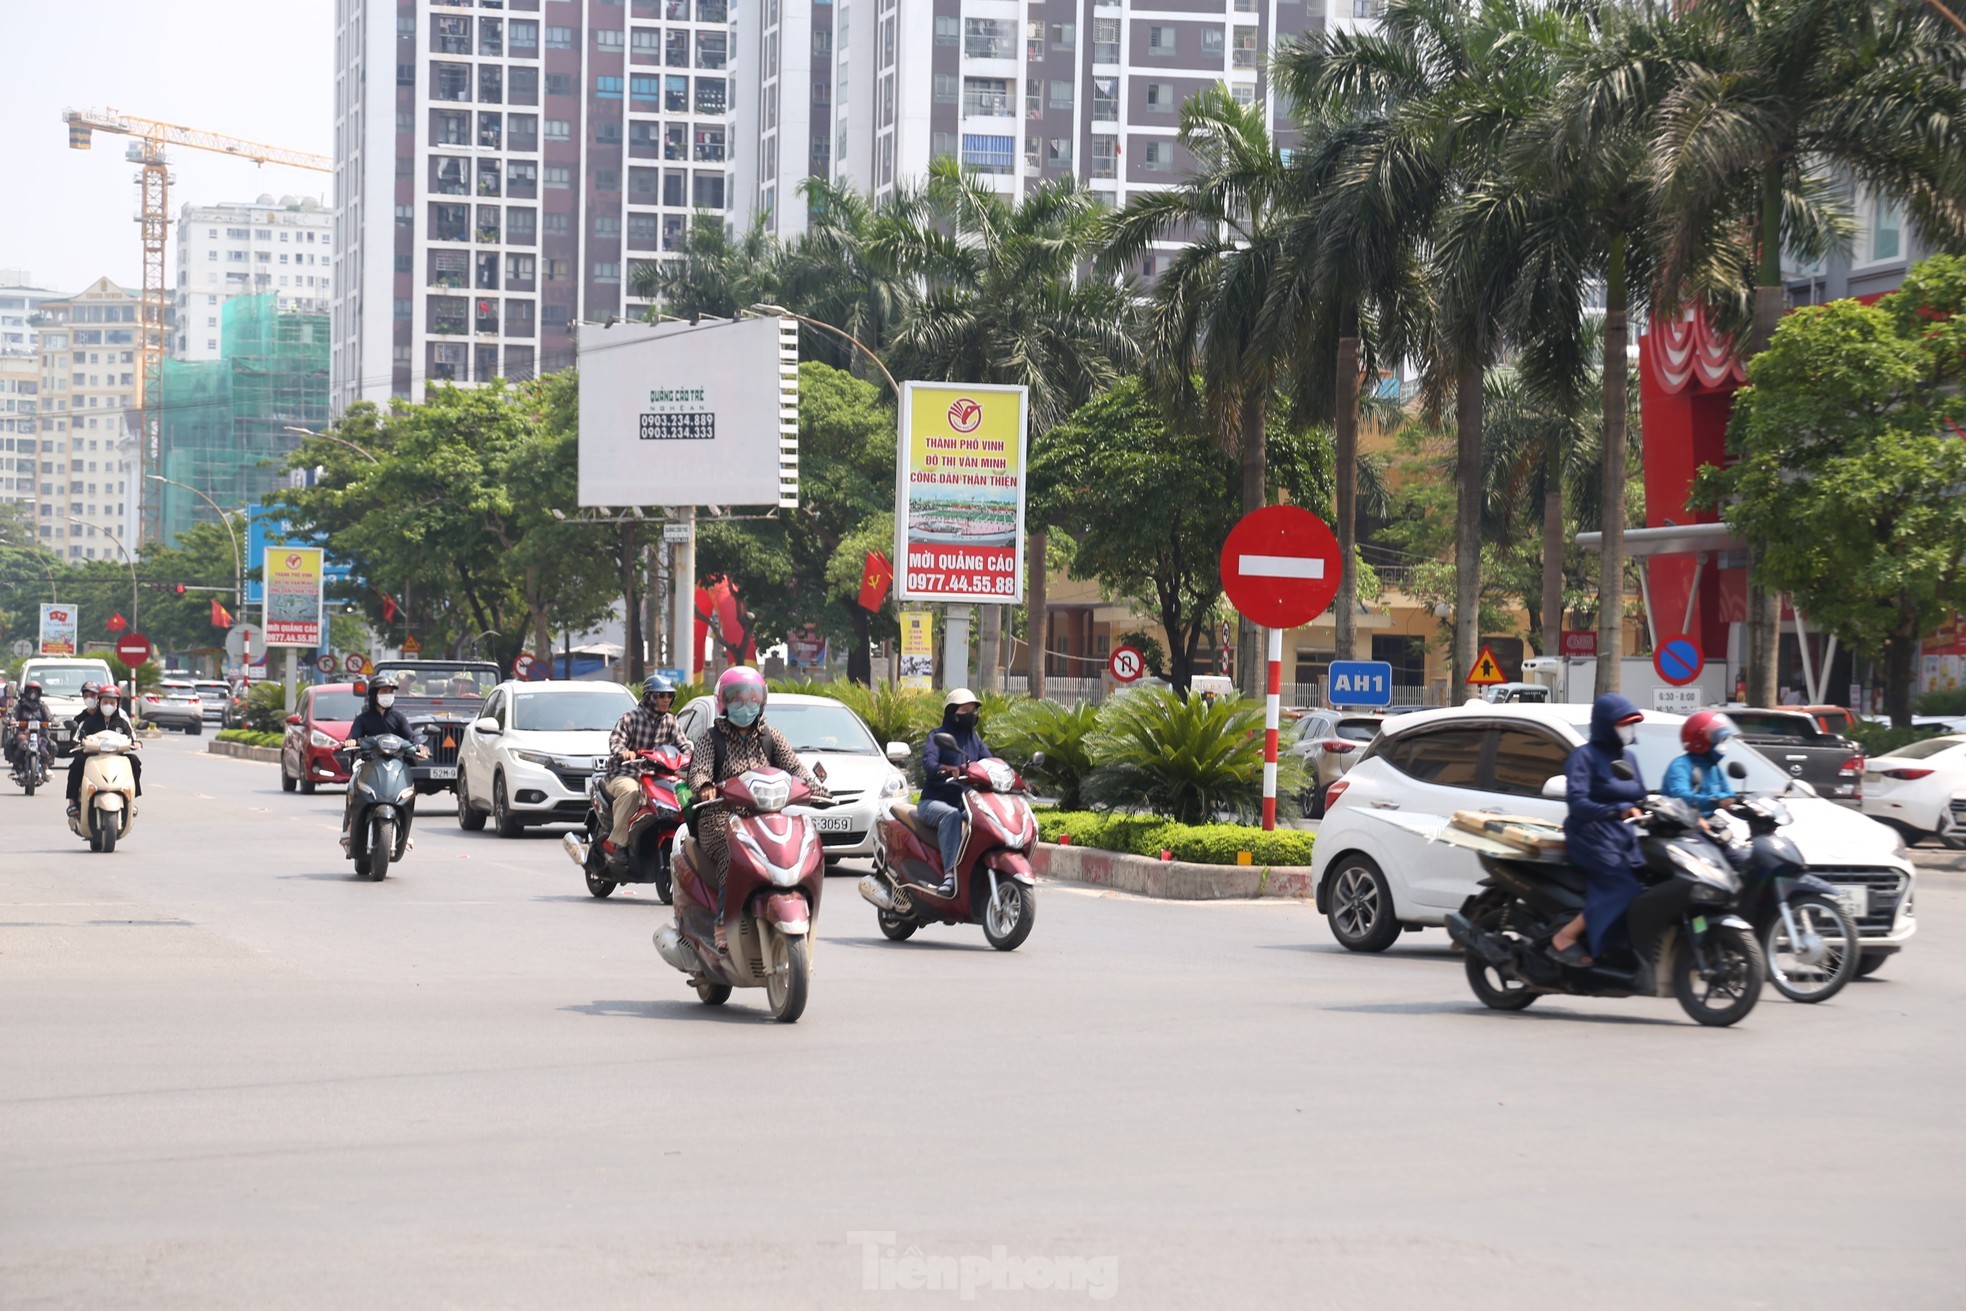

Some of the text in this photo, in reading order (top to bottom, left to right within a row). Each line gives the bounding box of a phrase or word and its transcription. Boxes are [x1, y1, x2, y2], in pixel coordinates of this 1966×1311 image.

[641, 414, 713, 427] 0903.234.889
[641, 426, 713, 439] 0903.234.333
[926, 436, 1004, 451] THÀNH PHỐ VINH
[925, 454, 1006, 469] ĐÔ THỊ VĂN MINH
[910, 470, 936, 484] CÔNG
[939, 472, 959, 485] DÂN
[990, 475, 1017, 489] THIỆN
[909, 550, 1014, 572] MỜI QUẢNG CÁO
[908, 573, 1014, 594] 0977.44.55.88
[1334, 674, 1383, 692] AH1
